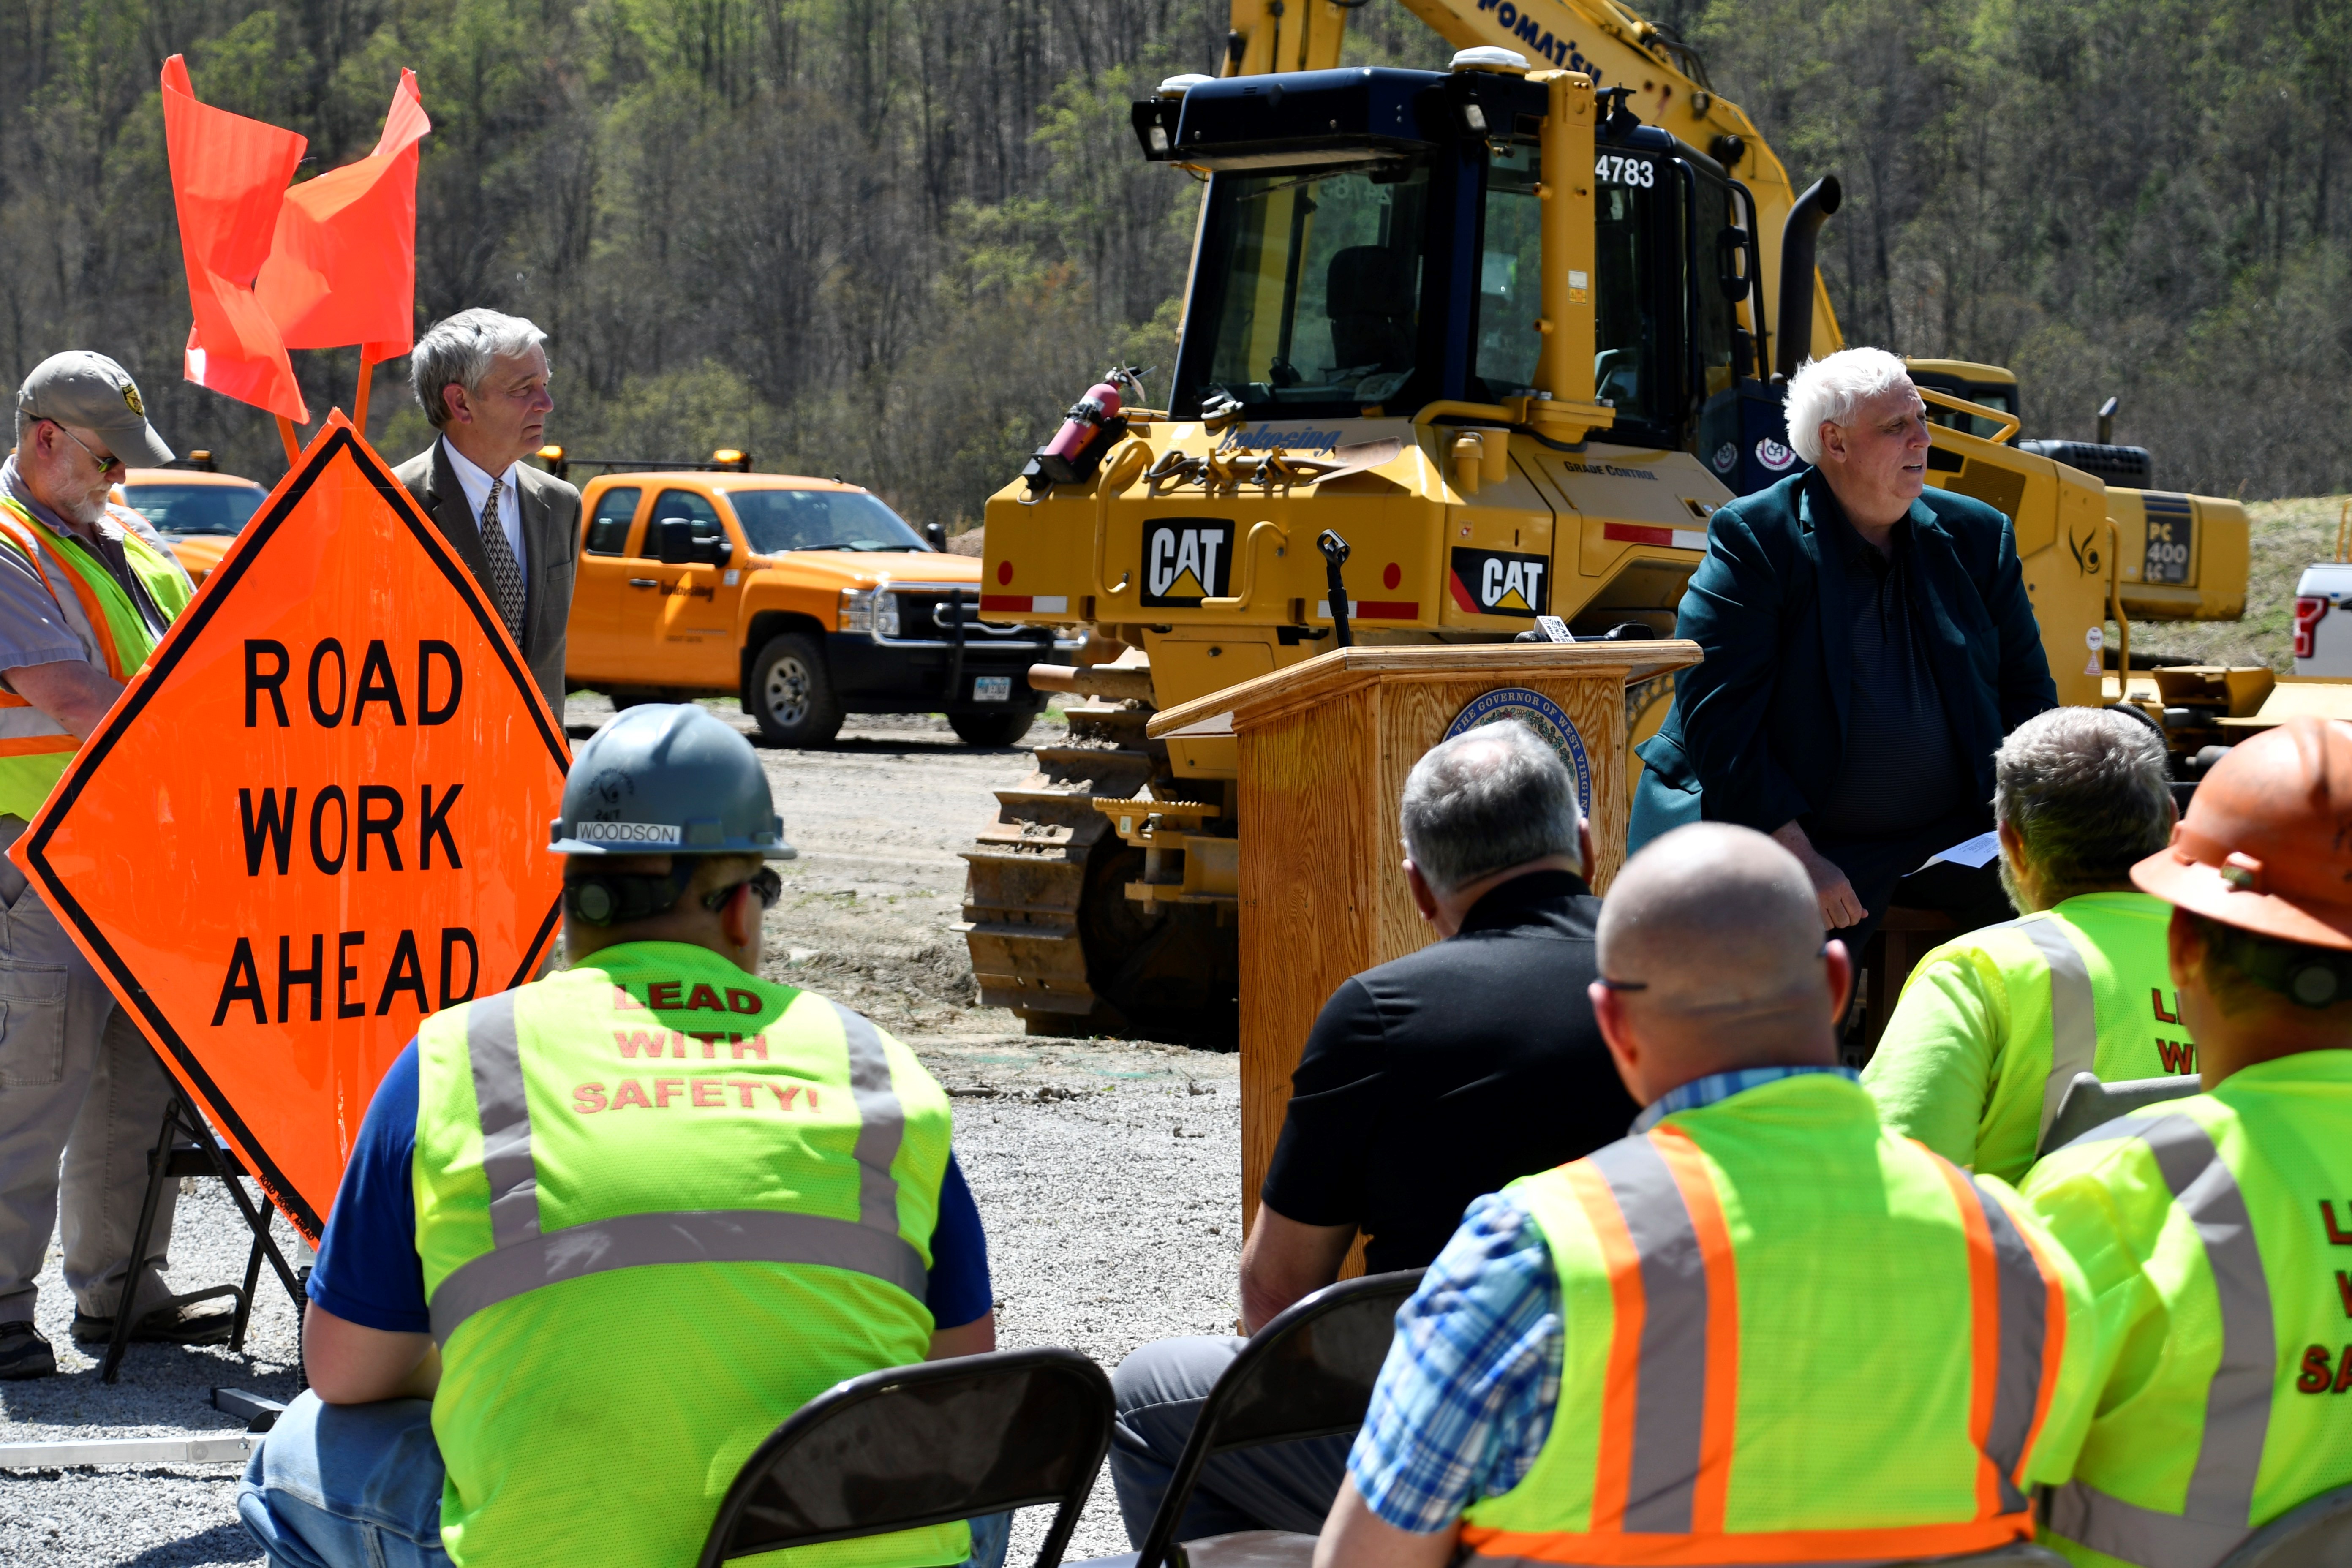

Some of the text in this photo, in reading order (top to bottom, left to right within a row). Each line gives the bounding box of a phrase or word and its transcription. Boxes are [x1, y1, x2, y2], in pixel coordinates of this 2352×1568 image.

[1595, 155, 1654, 188] 4783
[1564, 460, 1658, 480] GRADE CONTROL
[2149, 522, 2173, 542] PC
[1149, 528, 1224, 597] CAT
[2148, 542, 2188, 564] 400
[1482, 558, 1543, 611] CAT
[244, 637, 463, 728] ROAD
[1455, 708, 1476, 733] THE
[1478, 692, 1539, 711] GOVERNOR
[1543, 702, 1557, 716] OF
[1558, 715, 1580, 750] WEST
[239, 784, 464, 877] WORK
[580, 824, 675, 841] WOODSON
[210, 927, 478, 1026] AHEAD
[614, 981, 763, 1014] LEAD
[614, 1030, 768, 1060] WITH
[573, 1078, 820, 1114] SAFETY!
[259, 1174, 315, 1241] ROAD WORK AHEAD
